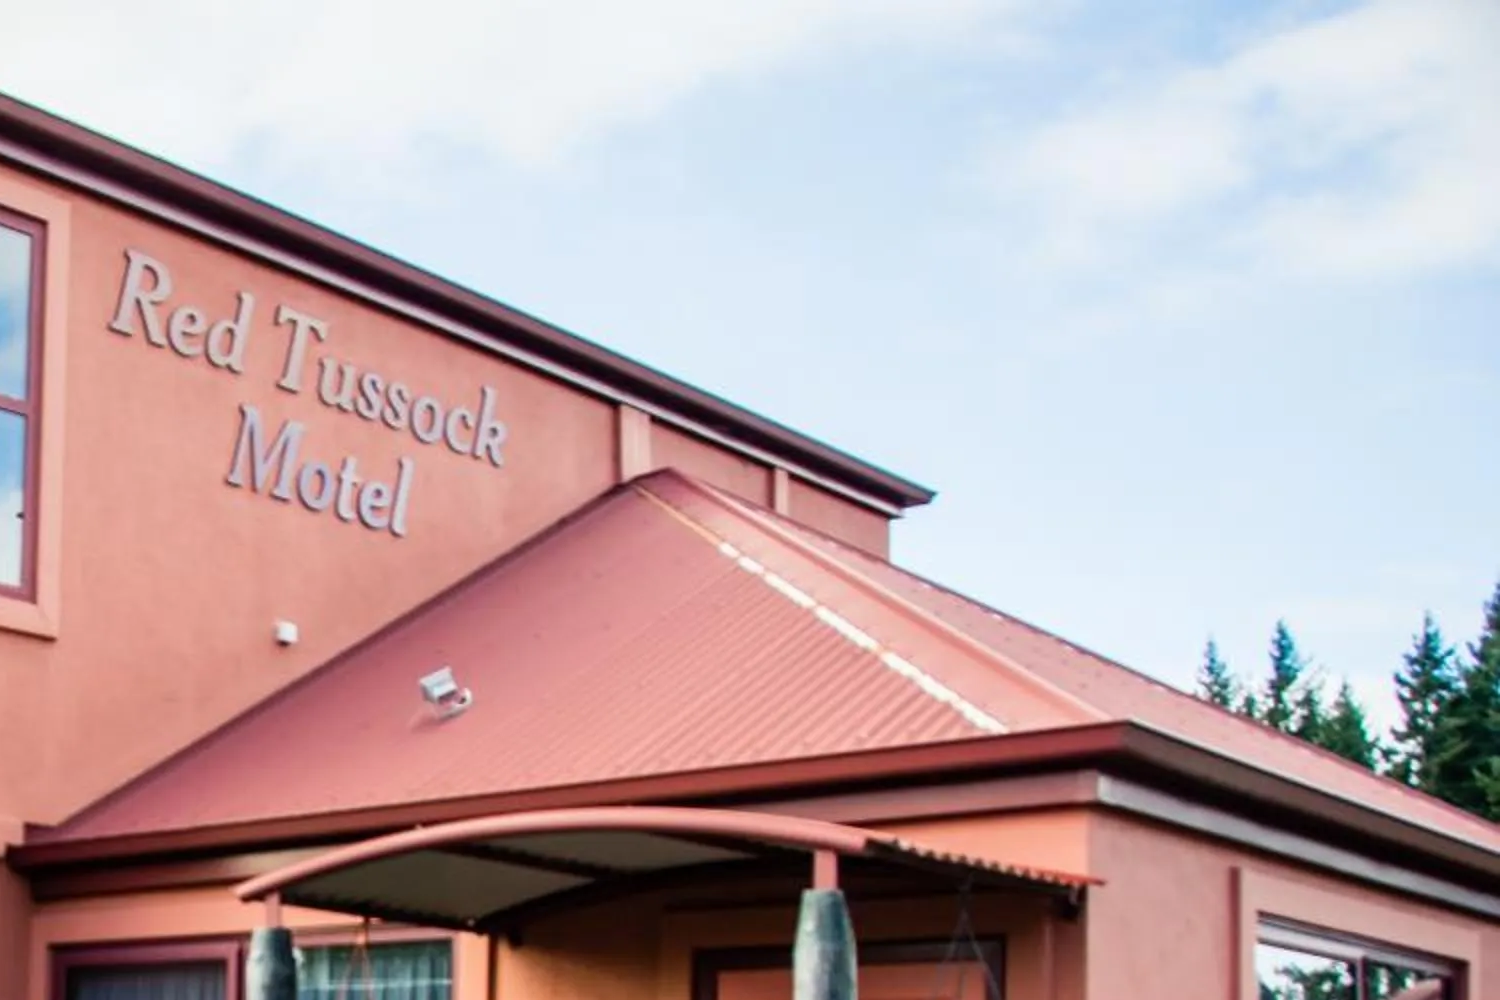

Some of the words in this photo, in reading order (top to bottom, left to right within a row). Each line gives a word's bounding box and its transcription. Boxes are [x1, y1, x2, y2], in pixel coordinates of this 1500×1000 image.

[108, 248, 254, 374] Red
[274, 305, 508, 468] Tussock
[225, 403, 414, 537] Motel
